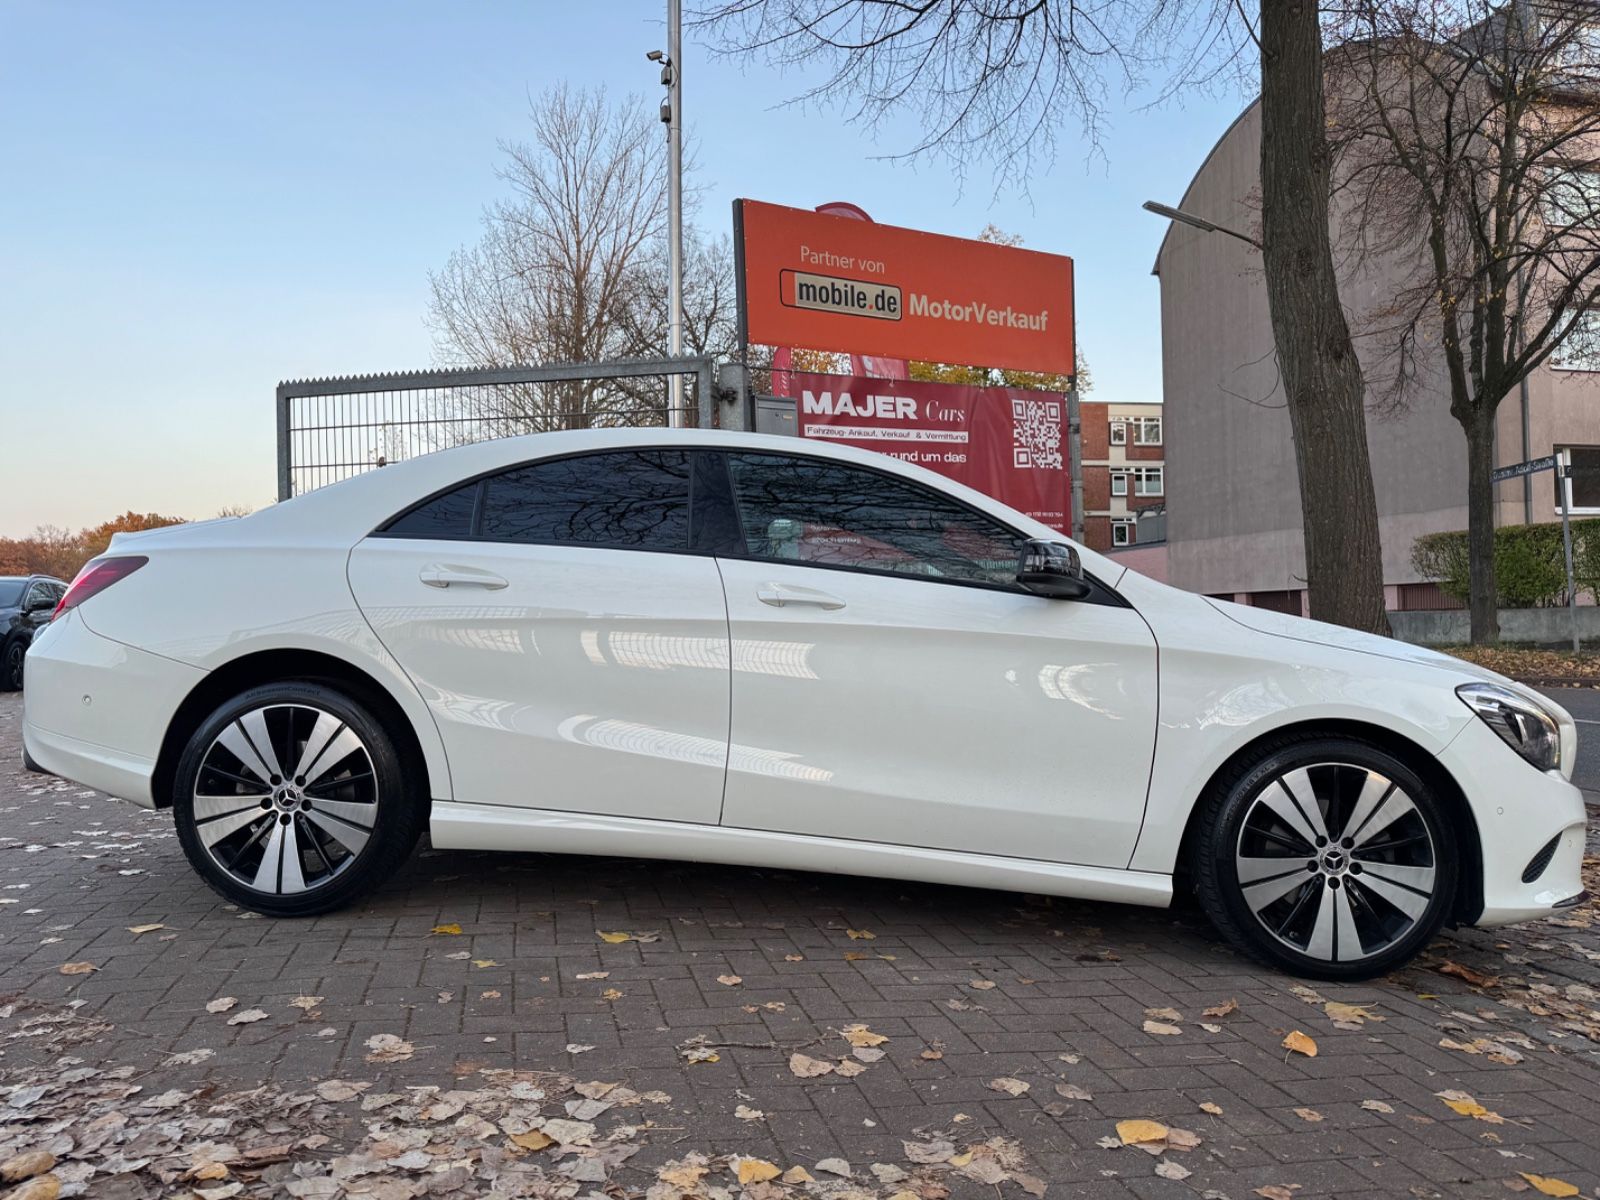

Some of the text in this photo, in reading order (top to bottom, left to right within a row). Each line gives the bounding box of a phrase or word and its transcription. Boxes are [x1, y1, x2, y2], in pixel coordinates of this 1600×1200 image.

[800, 245, 885, 273] Partner von
[799, 281, 1048, 331] mobile.de MotorVerkauf
[802, 390, 965, 422] MAJER Cars
[881, 430, 911, 439] Verkauf
[925, 433, 967, 441] Vermittlung
[921, 453, 941, 462] um
[943, 451, 967, 463] das
